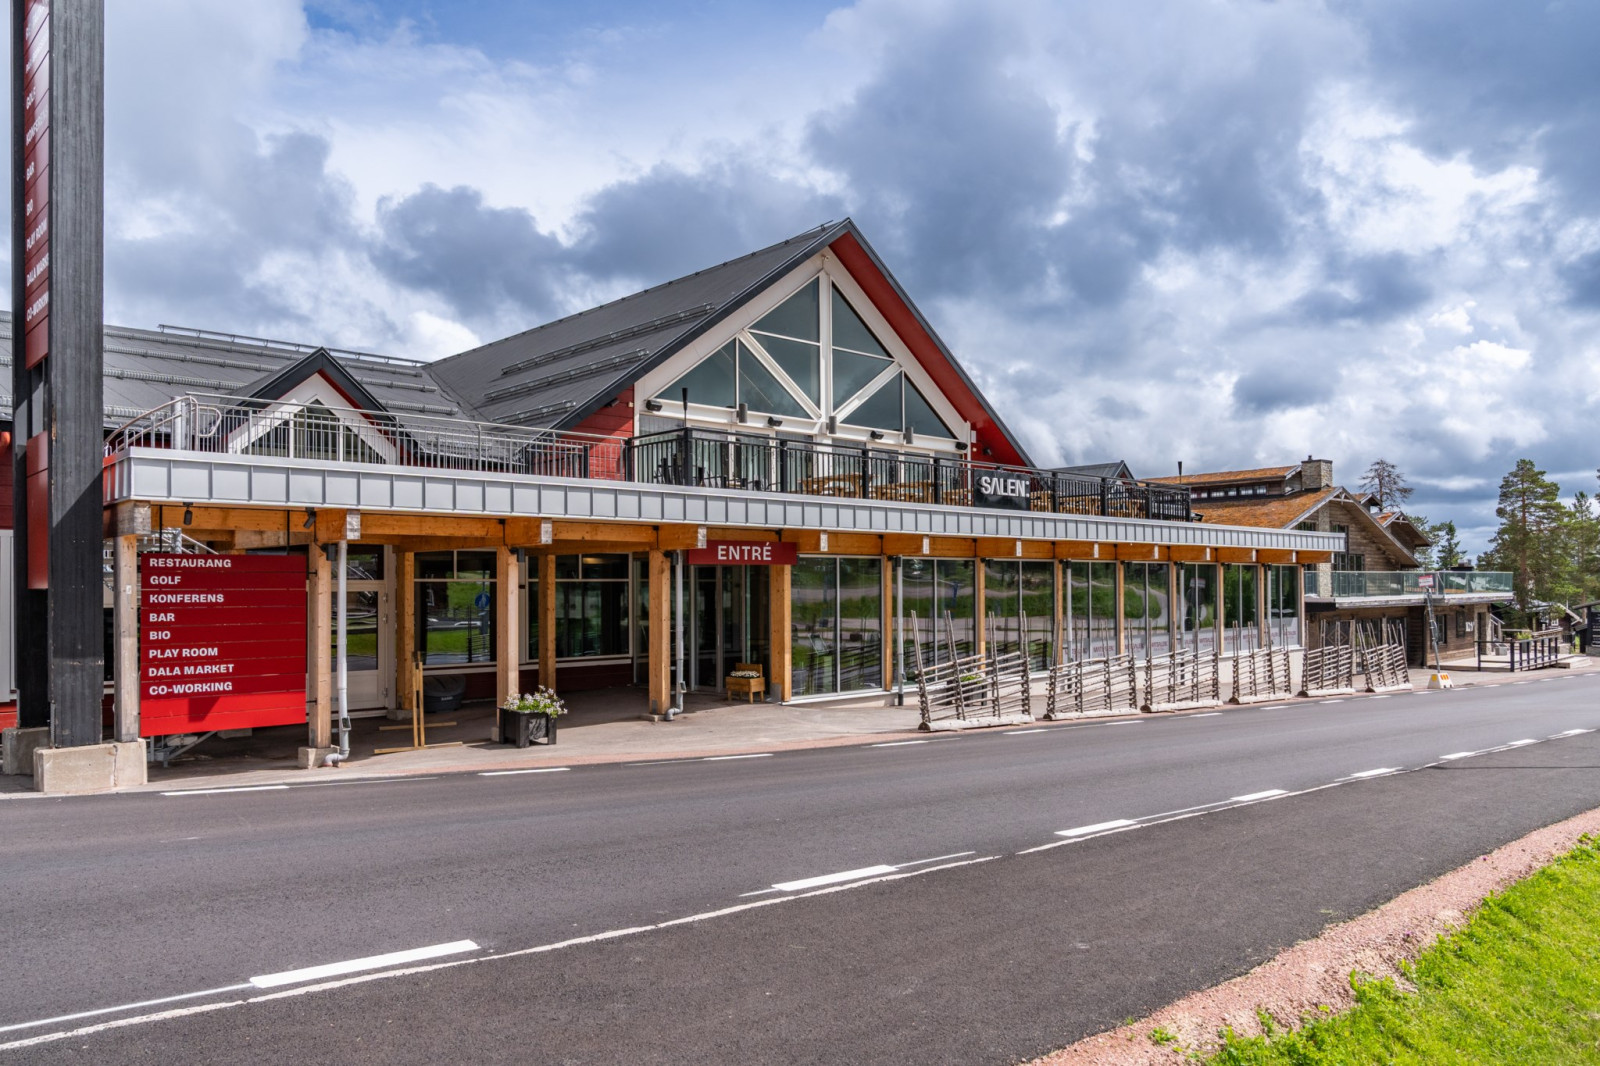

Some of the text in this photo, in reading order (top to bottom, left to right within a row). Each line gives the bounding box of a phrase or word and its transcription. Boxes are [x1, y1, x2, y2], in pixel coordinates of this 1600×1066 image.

[717, 541, 772, 561] ENTRÉ
[150, 558, 232, 568] RESTAURANG
[150, 575, 182, 585] GOLF
[149, 594, 224, 603] KONFERENS
[149, 613, 175, 622] BAR
[149, 631, 171, 640] BIO
[149, 647, 218, 659] PLAY ROOM
[148, 664, 234, 677] DALA MARKET
[149, 682, 233, 695] CO-WORKING
